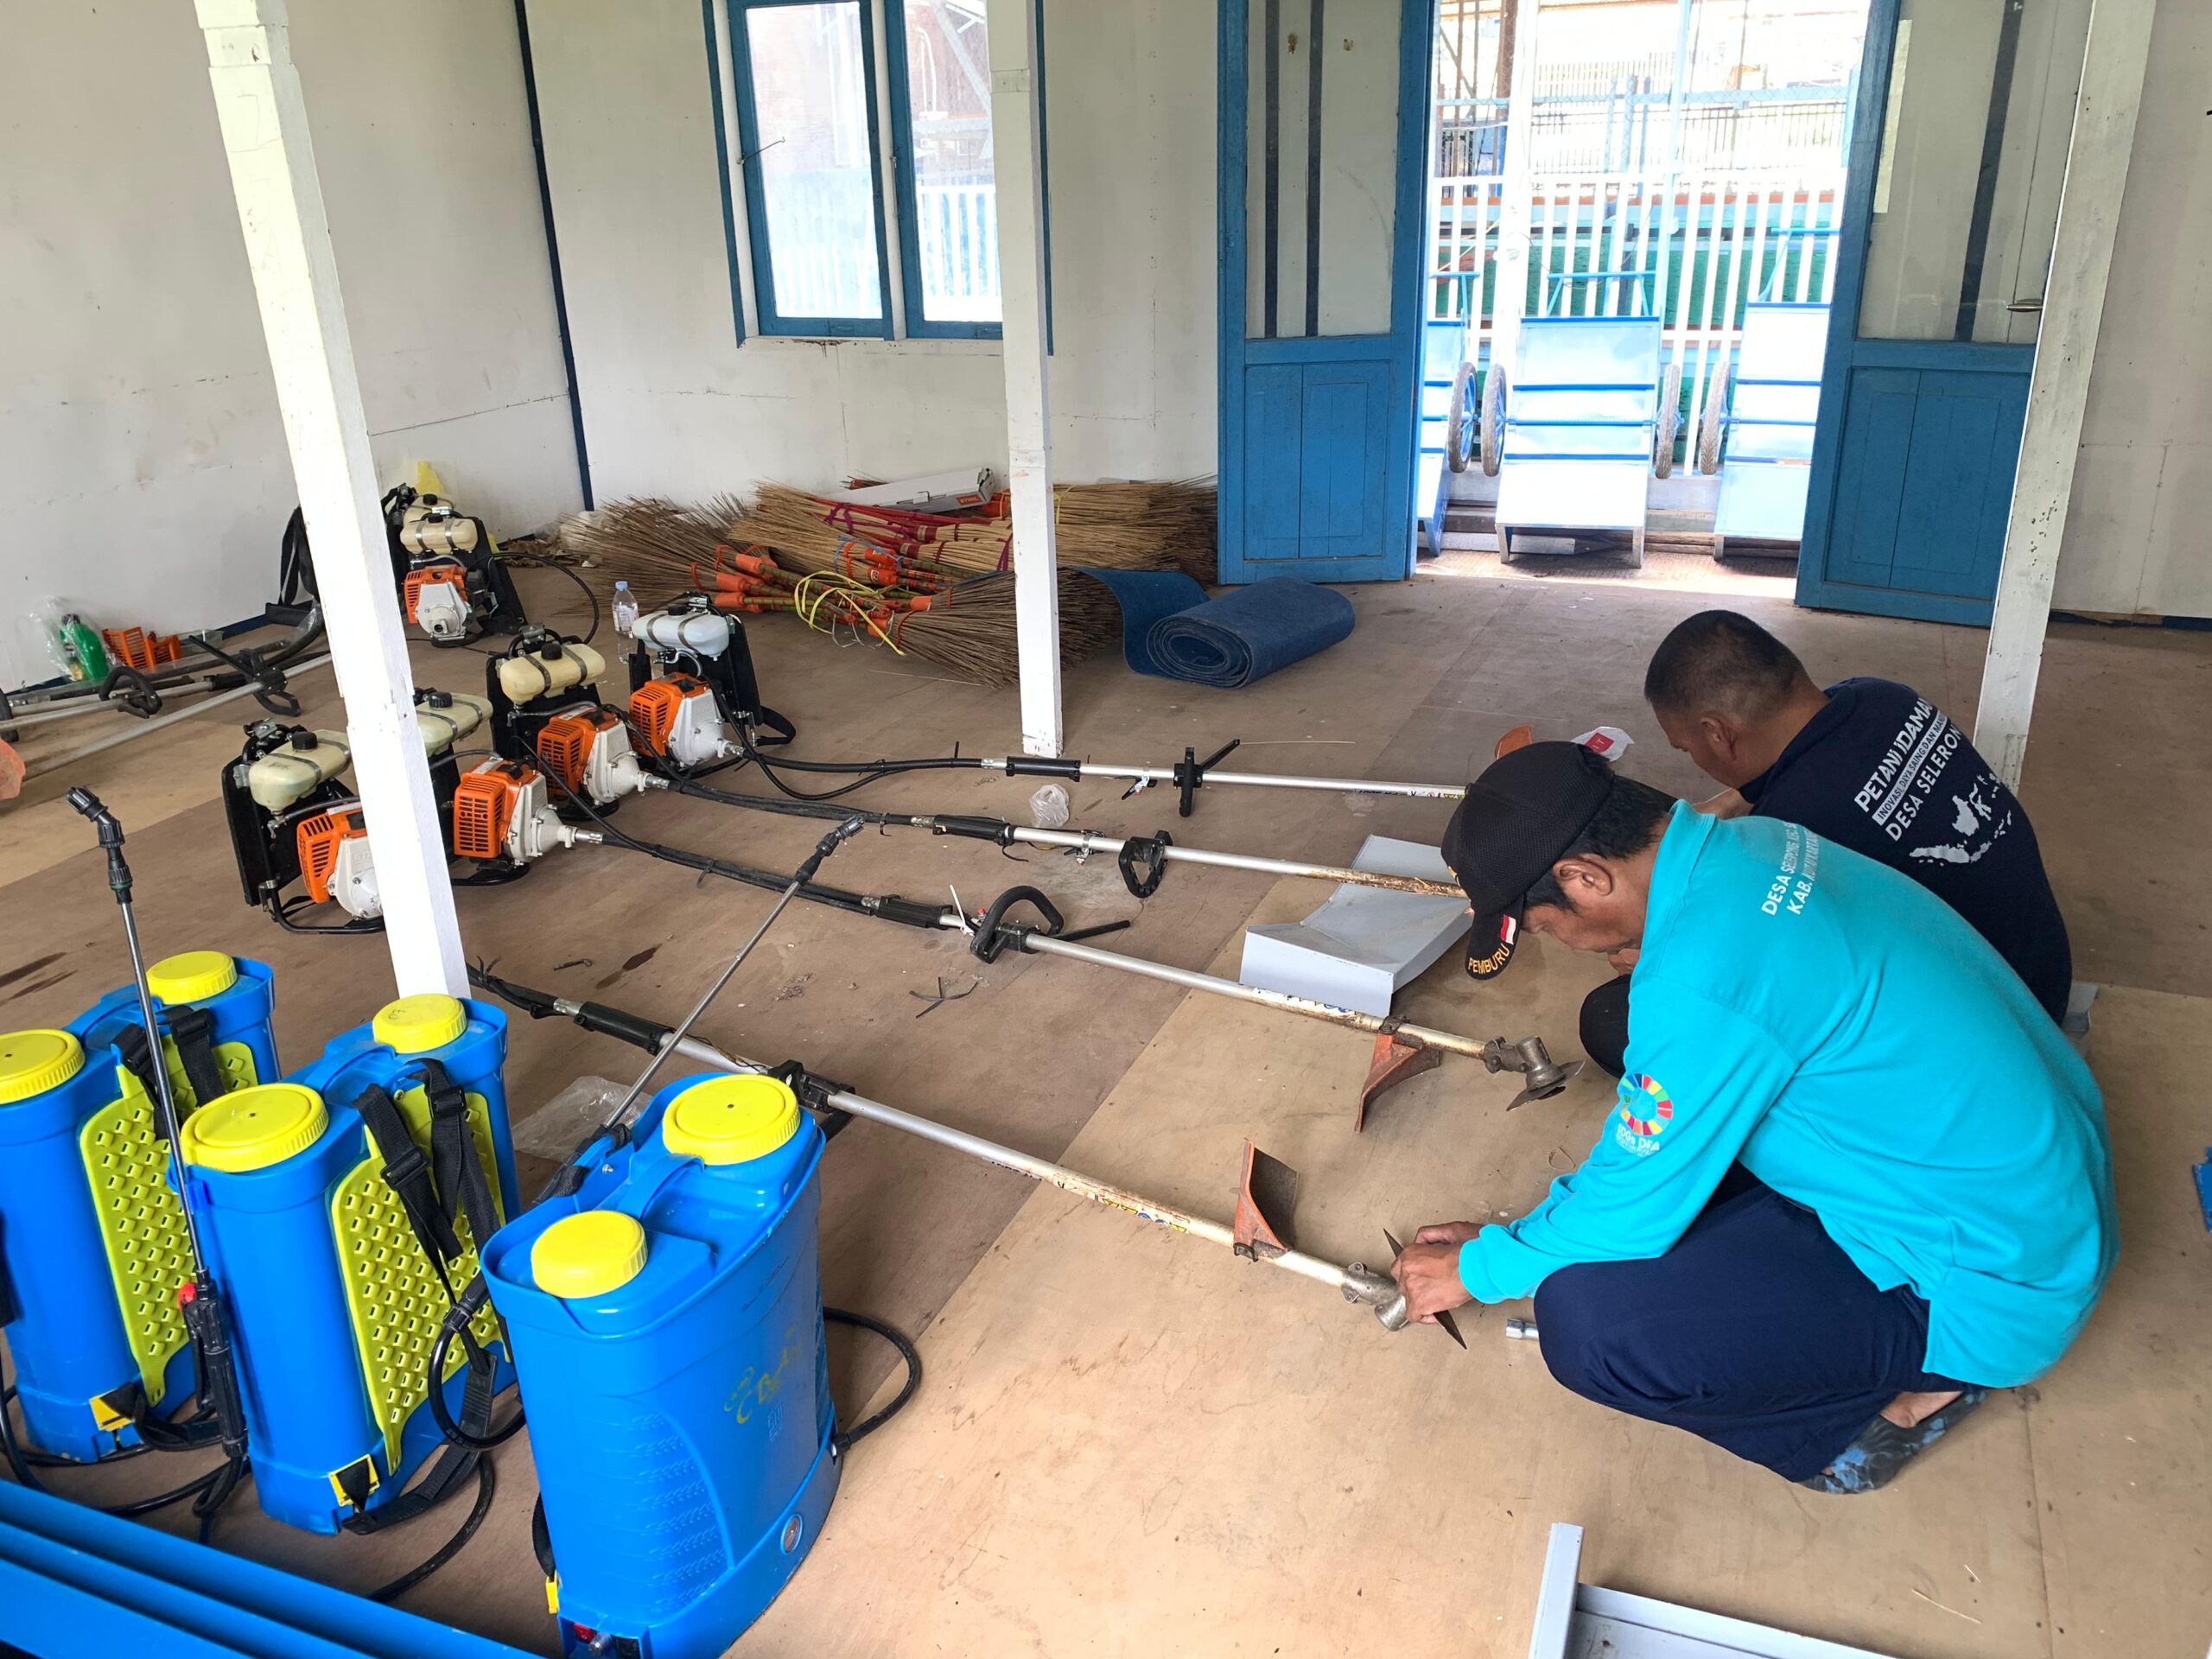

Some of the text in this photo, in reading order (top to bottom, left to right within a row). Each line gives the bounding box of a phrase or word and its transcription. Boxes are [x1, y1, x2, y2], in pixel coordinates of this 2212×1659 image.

[1854, 748, 1903, 812] PETANI
[1898, 769, 1913, 787] DAYA
[1909, 747, 1926, 771] SAING
[1922, 731, 1936, 750] DAN
[1885, 794, 1923, 841] DESA
[1761, 875, 1792, 916] DESA
[1786, 880, 1813, 915] KAB.
[1468, 943, 1510, 975] PEMBURU
